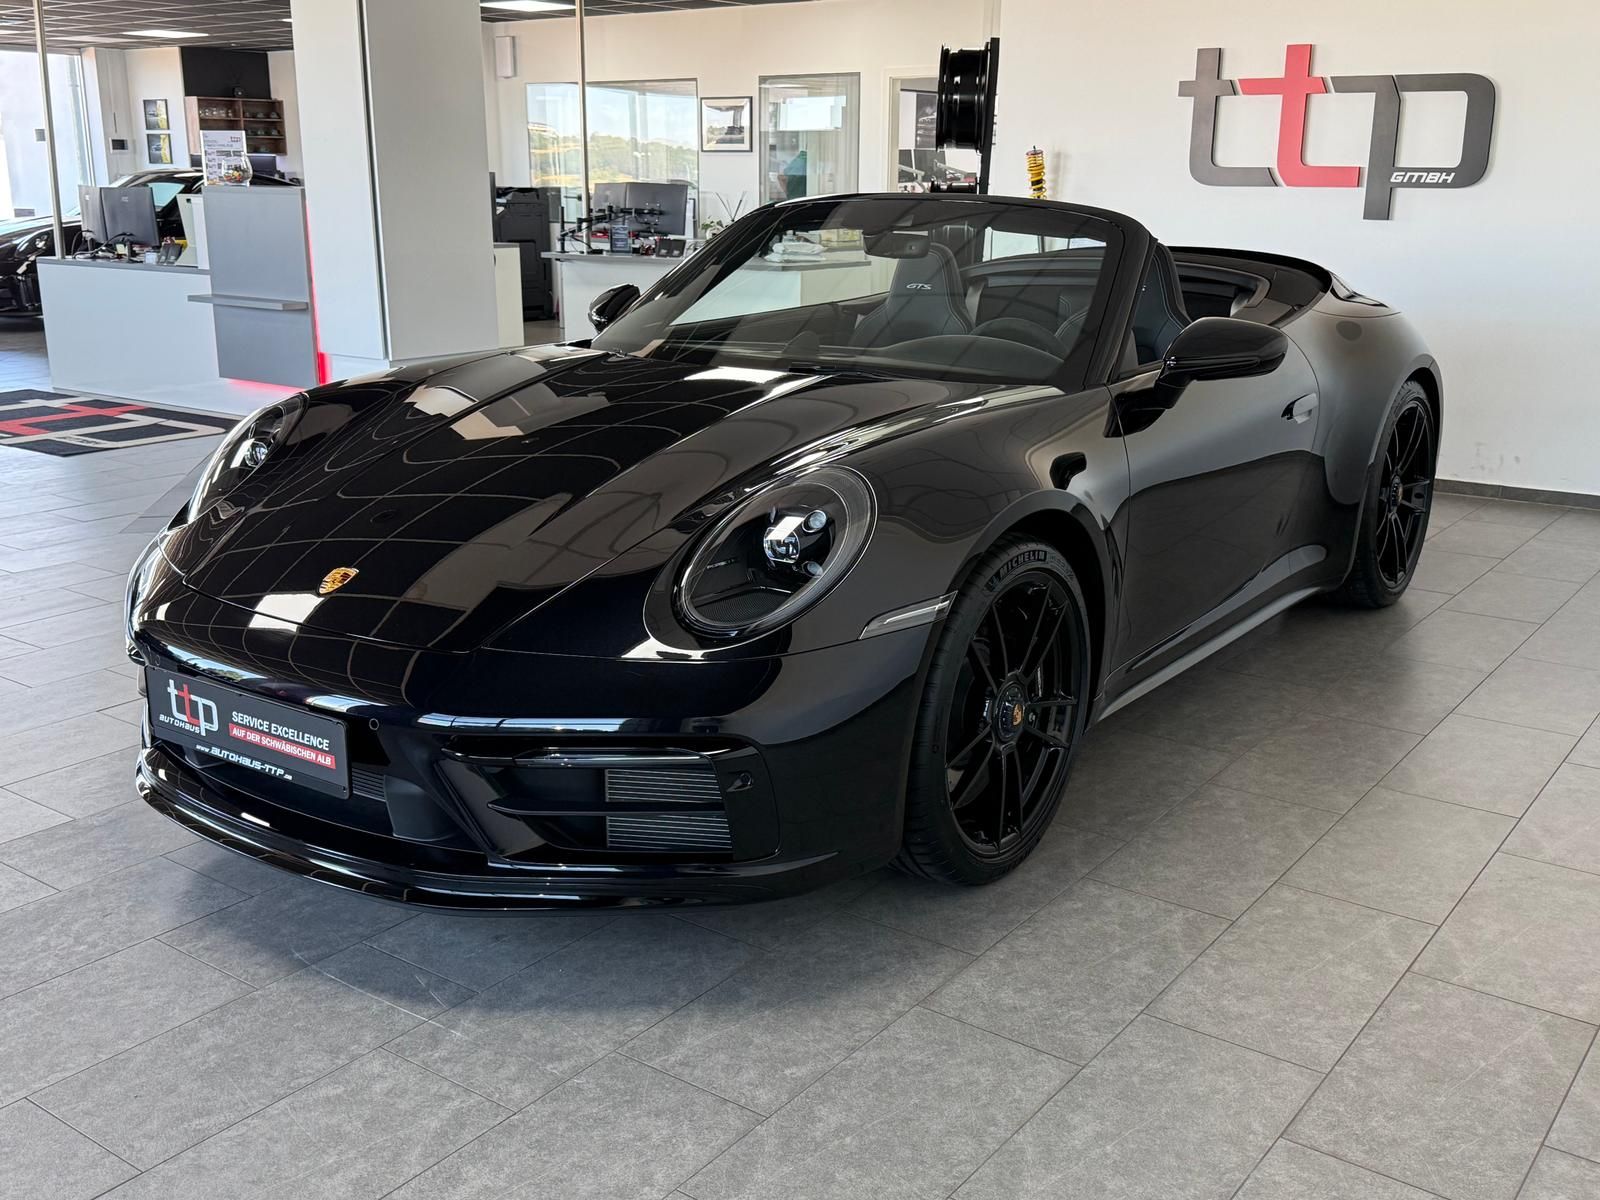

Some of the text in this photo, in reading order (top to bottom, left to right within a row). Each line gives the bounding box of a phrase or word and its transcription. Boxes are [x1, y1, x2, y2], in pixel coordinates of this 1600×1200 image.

[1178, 44, 1495, 220] ttp
[999, 550, 1045, 579] MICHELIN
[167, 679, 218, 736] ttp
[232, 711, 330, 751] SERVICE EXCELLENCE
[232, 727, 331, 765] AUF DER SCHWÄBISCHEN ALB
